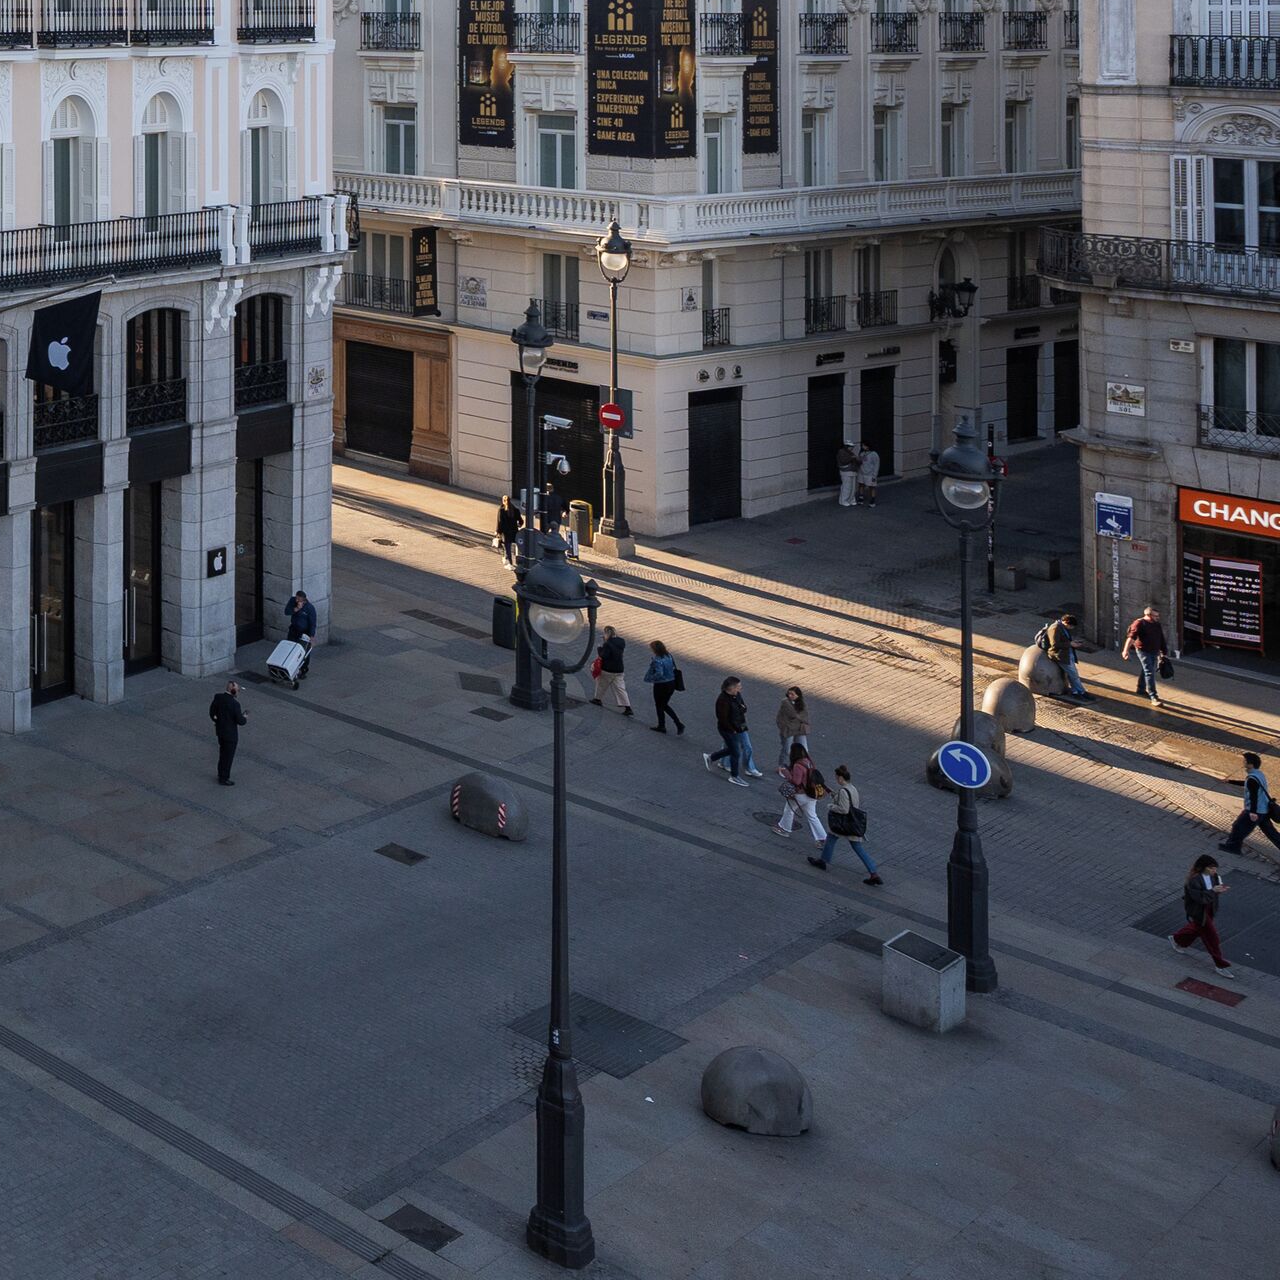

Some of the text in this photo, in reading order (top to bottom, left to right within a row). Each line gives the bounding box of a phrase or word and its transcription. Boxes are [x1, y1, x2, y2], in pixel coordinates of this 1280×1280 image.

[470, 0, 505, 11] EL MEJOR
[475, 12, 500, 22] MUSEO
[663, 9, 688, 20] FOOTBALL
[469, 21, 506, 34] DE FÚTBOL
[467, 34, 508, 46] DEL MUNDO
[594, 34, 647, 45] LEGENDS
[661, 34, 690, 46] THE WORLD
[596, 69, 648, 81] UNA COLECCIÓN
[596, 79, 617, 89] ÚNICA
[596, 93, 645, 105] EXPERIENCIAS
[596, 103, 639, 115] INMERSIVAS
[472, 117, 506, 126] LEGENDS
[596, 117, 623, 128] CINE 4D
[596, 130, 635, 142] GAME AREA
